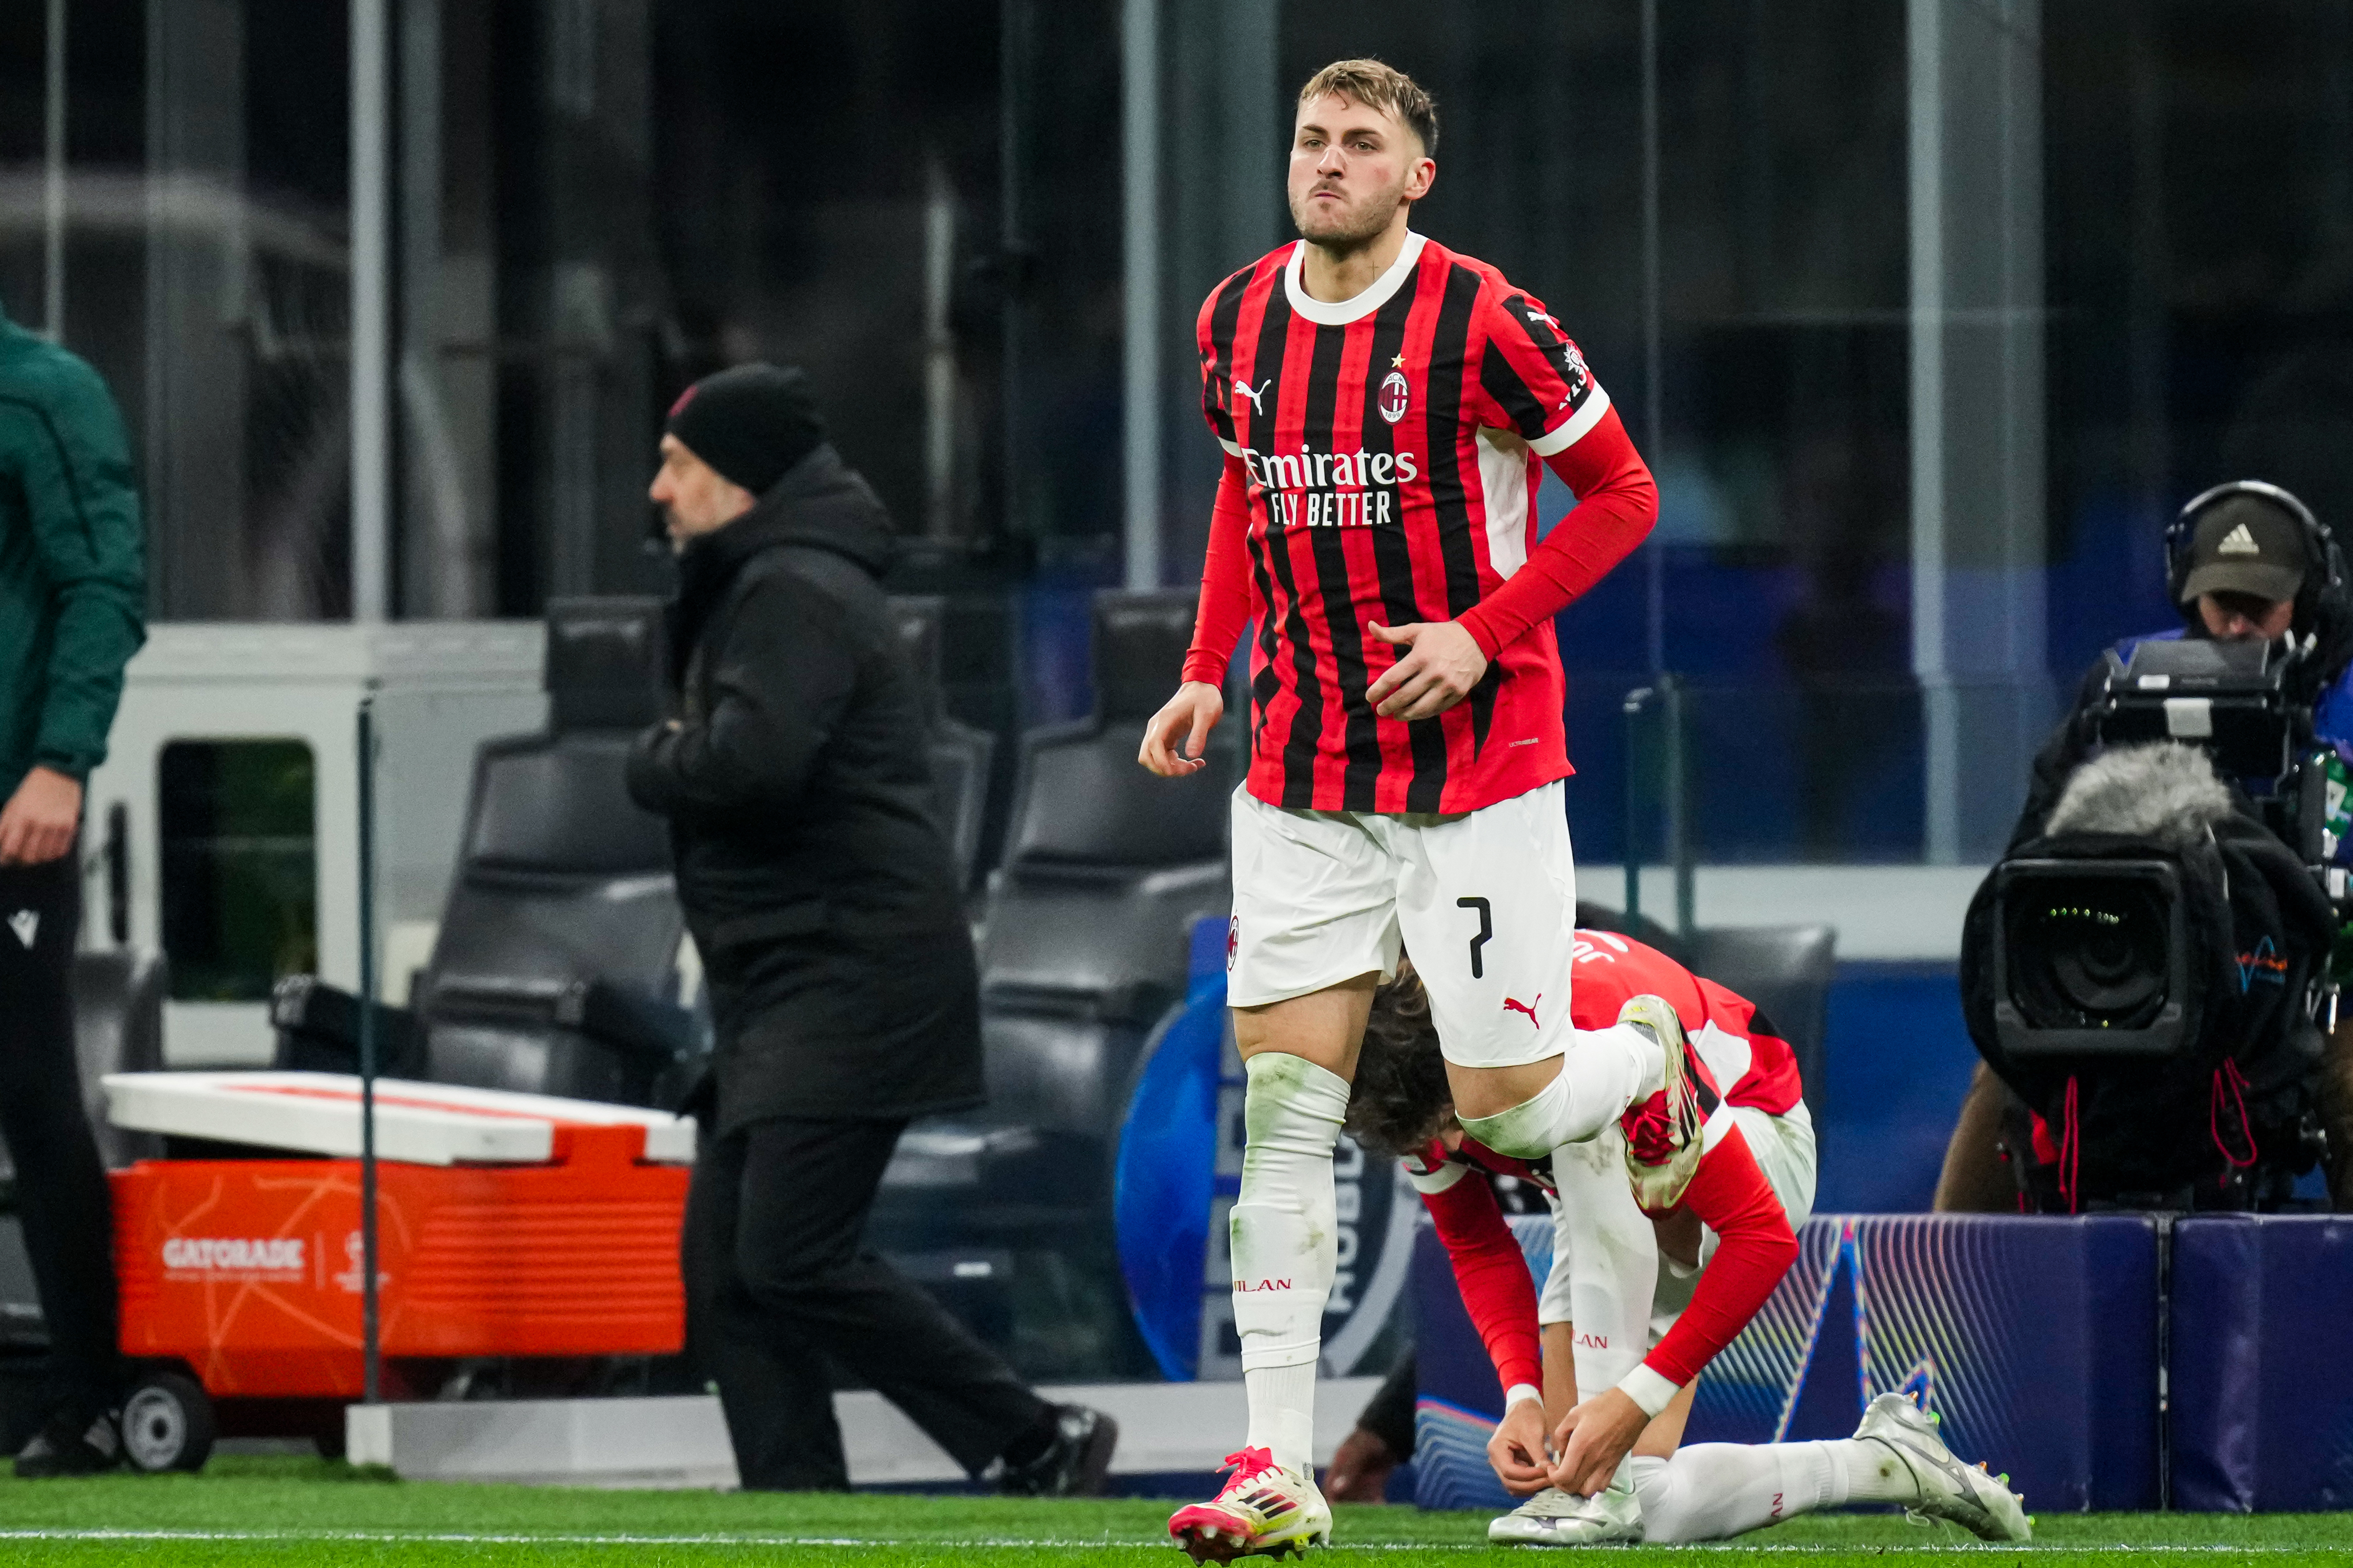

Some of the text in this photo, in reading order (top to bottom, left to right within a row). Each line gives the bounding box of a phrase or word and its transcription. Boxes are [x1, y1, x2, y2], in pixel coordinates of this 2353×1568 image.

[1386, 374, 1404, 384] ACM
[1241, 444, 1417, 488] Emirates
[1271, 491, 1391, 526] FLY BETTER
[1456, 896, 1492, 979] 7
[163, 1238, 304, 1268] GATORADE
